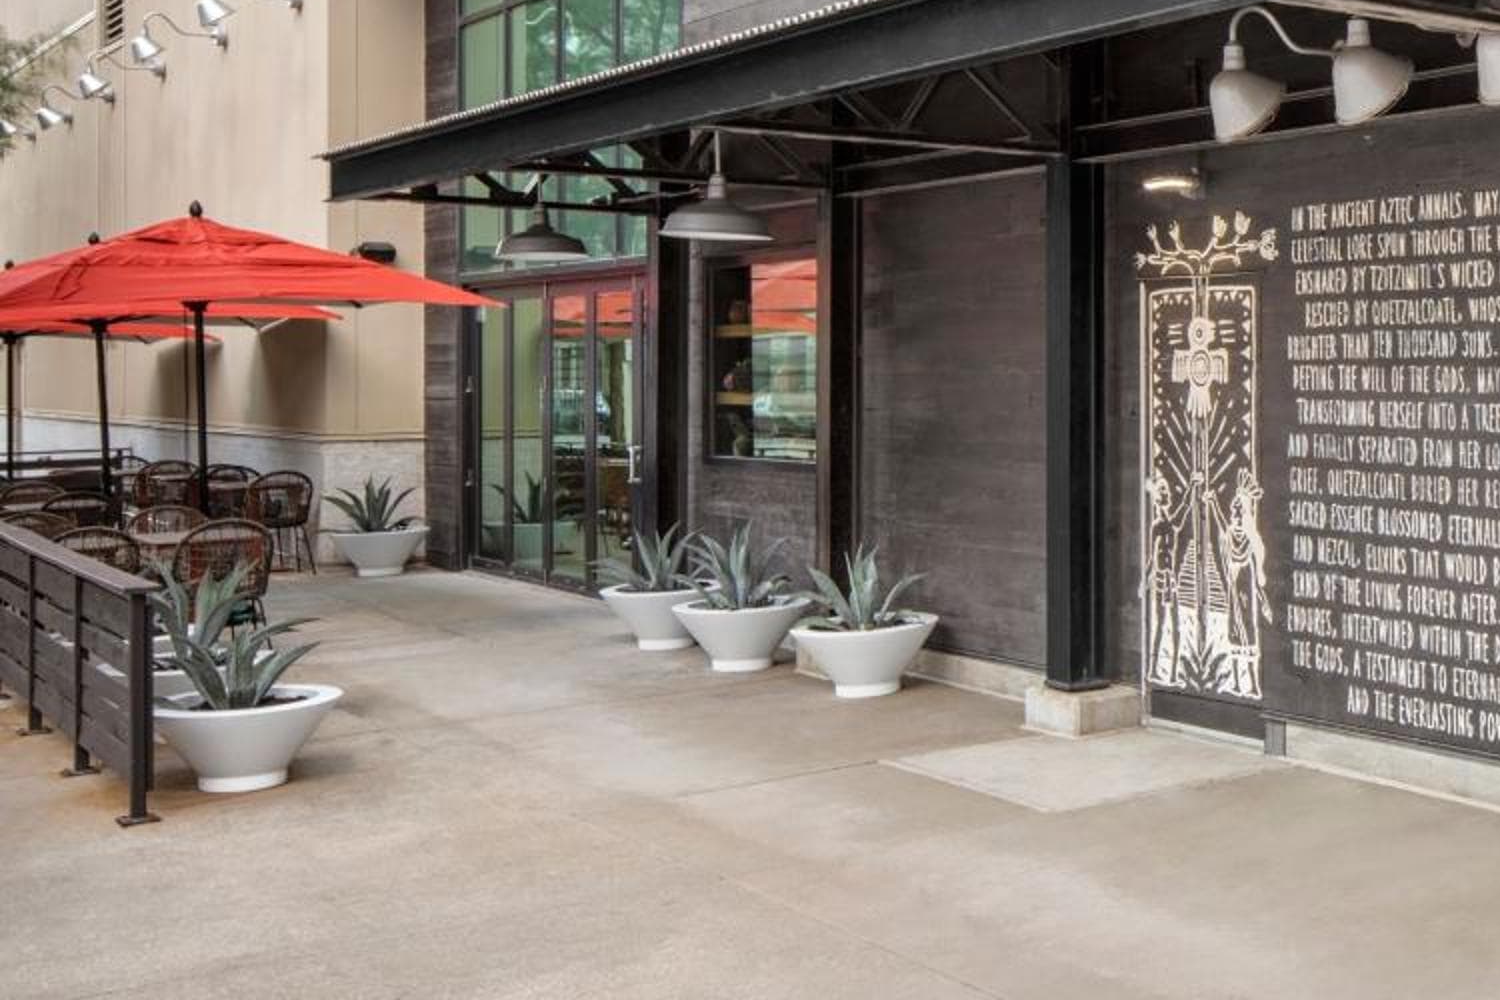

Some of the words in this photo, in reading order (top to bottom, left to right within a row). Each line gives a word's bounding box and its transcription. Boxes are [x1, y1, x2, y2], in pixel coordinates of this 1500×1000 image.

[1292, 207, 1304, 232] IN
[1307, 205, 1328, 231] THE
[1332, 201, 1375, 229] ANCIENT
[1380, 197, 1414, 225] AZTEC
[1291, 235, 1342, 264] CELESTIAL
[1347, 233, 1372, 260] LORE
[1377, 231, 1406, 258] SPUN
[1410, 227, 1464, 256] THROUGH
[1468, 225, 1492, 252] THE
[1352, 267, 1367, 292] BY
[1450, 260, 1495, 288] WICKED
[1305, 301, 1349, 328] RESCUED
[1354, 300, 1369, 327] BY
[1287, 333, 1337, 360] BRIGHTER
[1341, 331, 1369, 359] THAN
[1373, 330, 1393, 358] TEN
[1397, 330, 1457, 358] THOUSAND
[1293, 365, 1334, 390] DEFYING
[1338, 365, 1357, 391] THE
[1361, 365, 1387, 392] WILL
[1391, 366, 1405, 392] OF
[1408, 366, 1430, 393] THE
[1379, 400, 1424, 430] HERSELF
[1427, 402, 1457, 431] INTO
[1461, 403, 1469, 432] A
[1287, 433, 1309, 460] AND
[1358, 435, 1418, 467] SEPARATED
[1423, 438, 1453, 469] FROM
[1459, 440, 1481, 471] HER
[1327, 468, 1407, 501] QUETZALCOATL
[1411, 474, 1451, 505] BURIED
[1457, 476, 1479, 507] HER
[1289, 499, 1327, 530] SACRED
[1330, 502, 1374, 535] ESSENCE
[1377, 506, 1443, 542] BLOSSOMED
[1293, 534, 1313, 564] AND
[1365, 543, 1408, 575] ELIXIRS
[1410, 548, 1440, 579] THAT
[1444, 551, 1488, 585] WOULD
[1293, 570, 1321, 601] LAND
[1323, 574, 1337, 603] OF
[1342, 576, 1361, 607] THE
[1365, 579, 1403, 612] LIVING
[1407, 585, 1457, 620] FOREVER
[1342, 612, 1415, 651] INTERTWINED
[1419, 623, 1461, 658] WITHIN
[1465, 629, 1489, 662] THE
[1292, 639, 1312, 671] THE
[1353, 649, 1362, 679] A
[1366, 651, 1426, 691] TESTAMENT
[1431, 662, 1448, 695] TO
[1347, 684, 1370, 718] AND
[1373, 689, 1395, 723] THE
[1399, 695, 1474, 739] EVERLASTING
